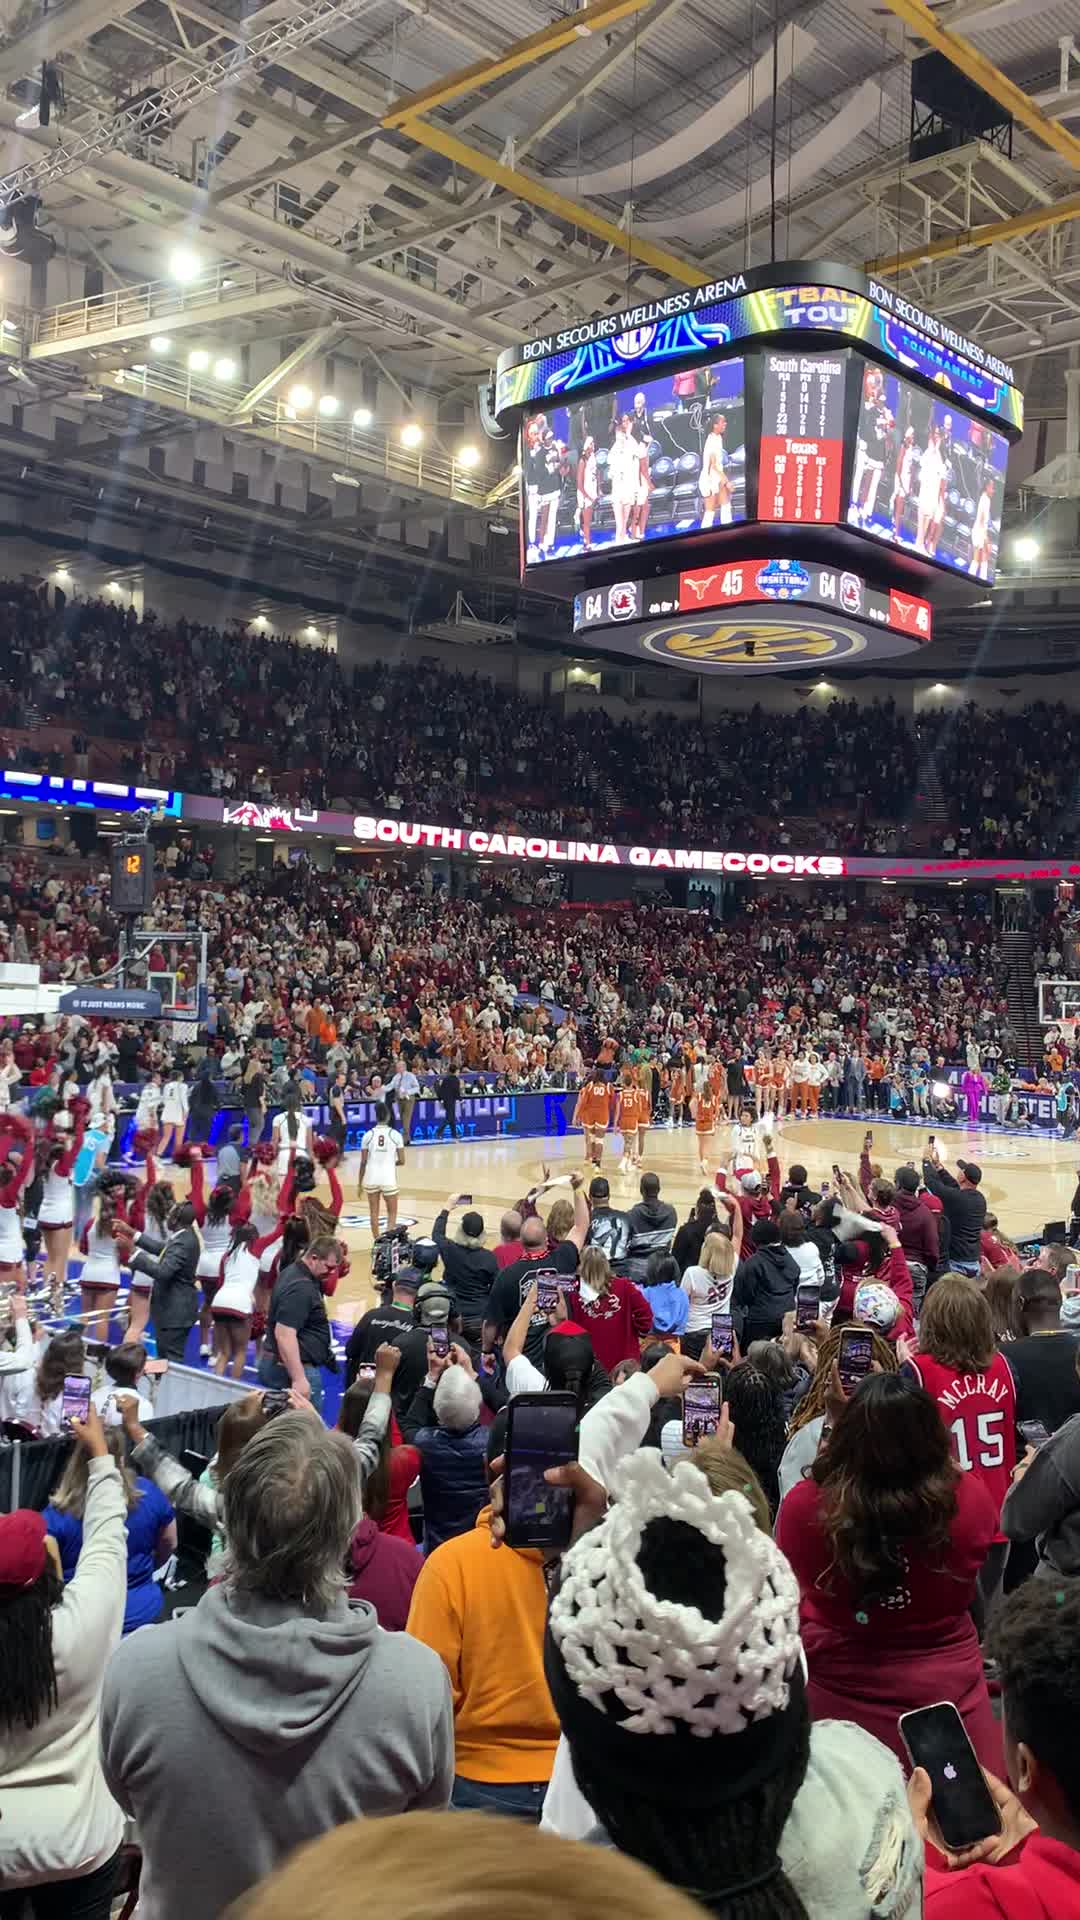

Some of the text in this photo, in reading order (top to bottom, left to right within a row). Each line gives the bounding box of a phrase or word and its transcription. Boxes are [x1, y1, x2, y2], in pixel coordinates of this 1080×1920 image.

[522, 337, 552, 360] BON
[556, 316, 617, 350] SECOURS
[620, 292, 691, 329] WELLNESS
[693, 274, 747, 306] ARENA
[869, 280, 1015, 384] BON SECOURS WELLNESS ARENA
[769, 357, 841, 375] South Carolina
[782, 381, 827, 393] 1 0 0
[780, 391, 827, 404] 5 14 2
[779, 402, 826, 415] 8 11 1
[776, 412, 826, 426] 23 2 2
[800, 425, 806, 436] 0
[820, 426, 824, 437] 1
[785, 439, 818, 455] Texas
[797, 464, 804, 475] 2
[818, 465, 822, 476] 1
[777, 474, 782, 485] 1
[797, 475, 804, 486] 2
[776, 485, 783, 496] 7
[816, 487, 823, 498] 3
[774, 496, 821, 509] 10 1 1
[720, 568, 744, 596] 45
[819, 571, 837, 599] 64
[585, 594, 602, 620] 64
[353, 815, 844, 876] SOUTH CAROLINA GAMECOCKS
[127, 855, 141, 873] 12
[80, 1000, 88, 1008] IT
[88, 1000, 103, 1009] JUST
[103, 1001, 125, 1009] MEANS
[623, 1098, 633, 1107] 13
[378, 1135, 385, 1147] 8
[937, 1373, 1009, 1410] MCCRAY
[951, 1411, 1004, 1471] 15
